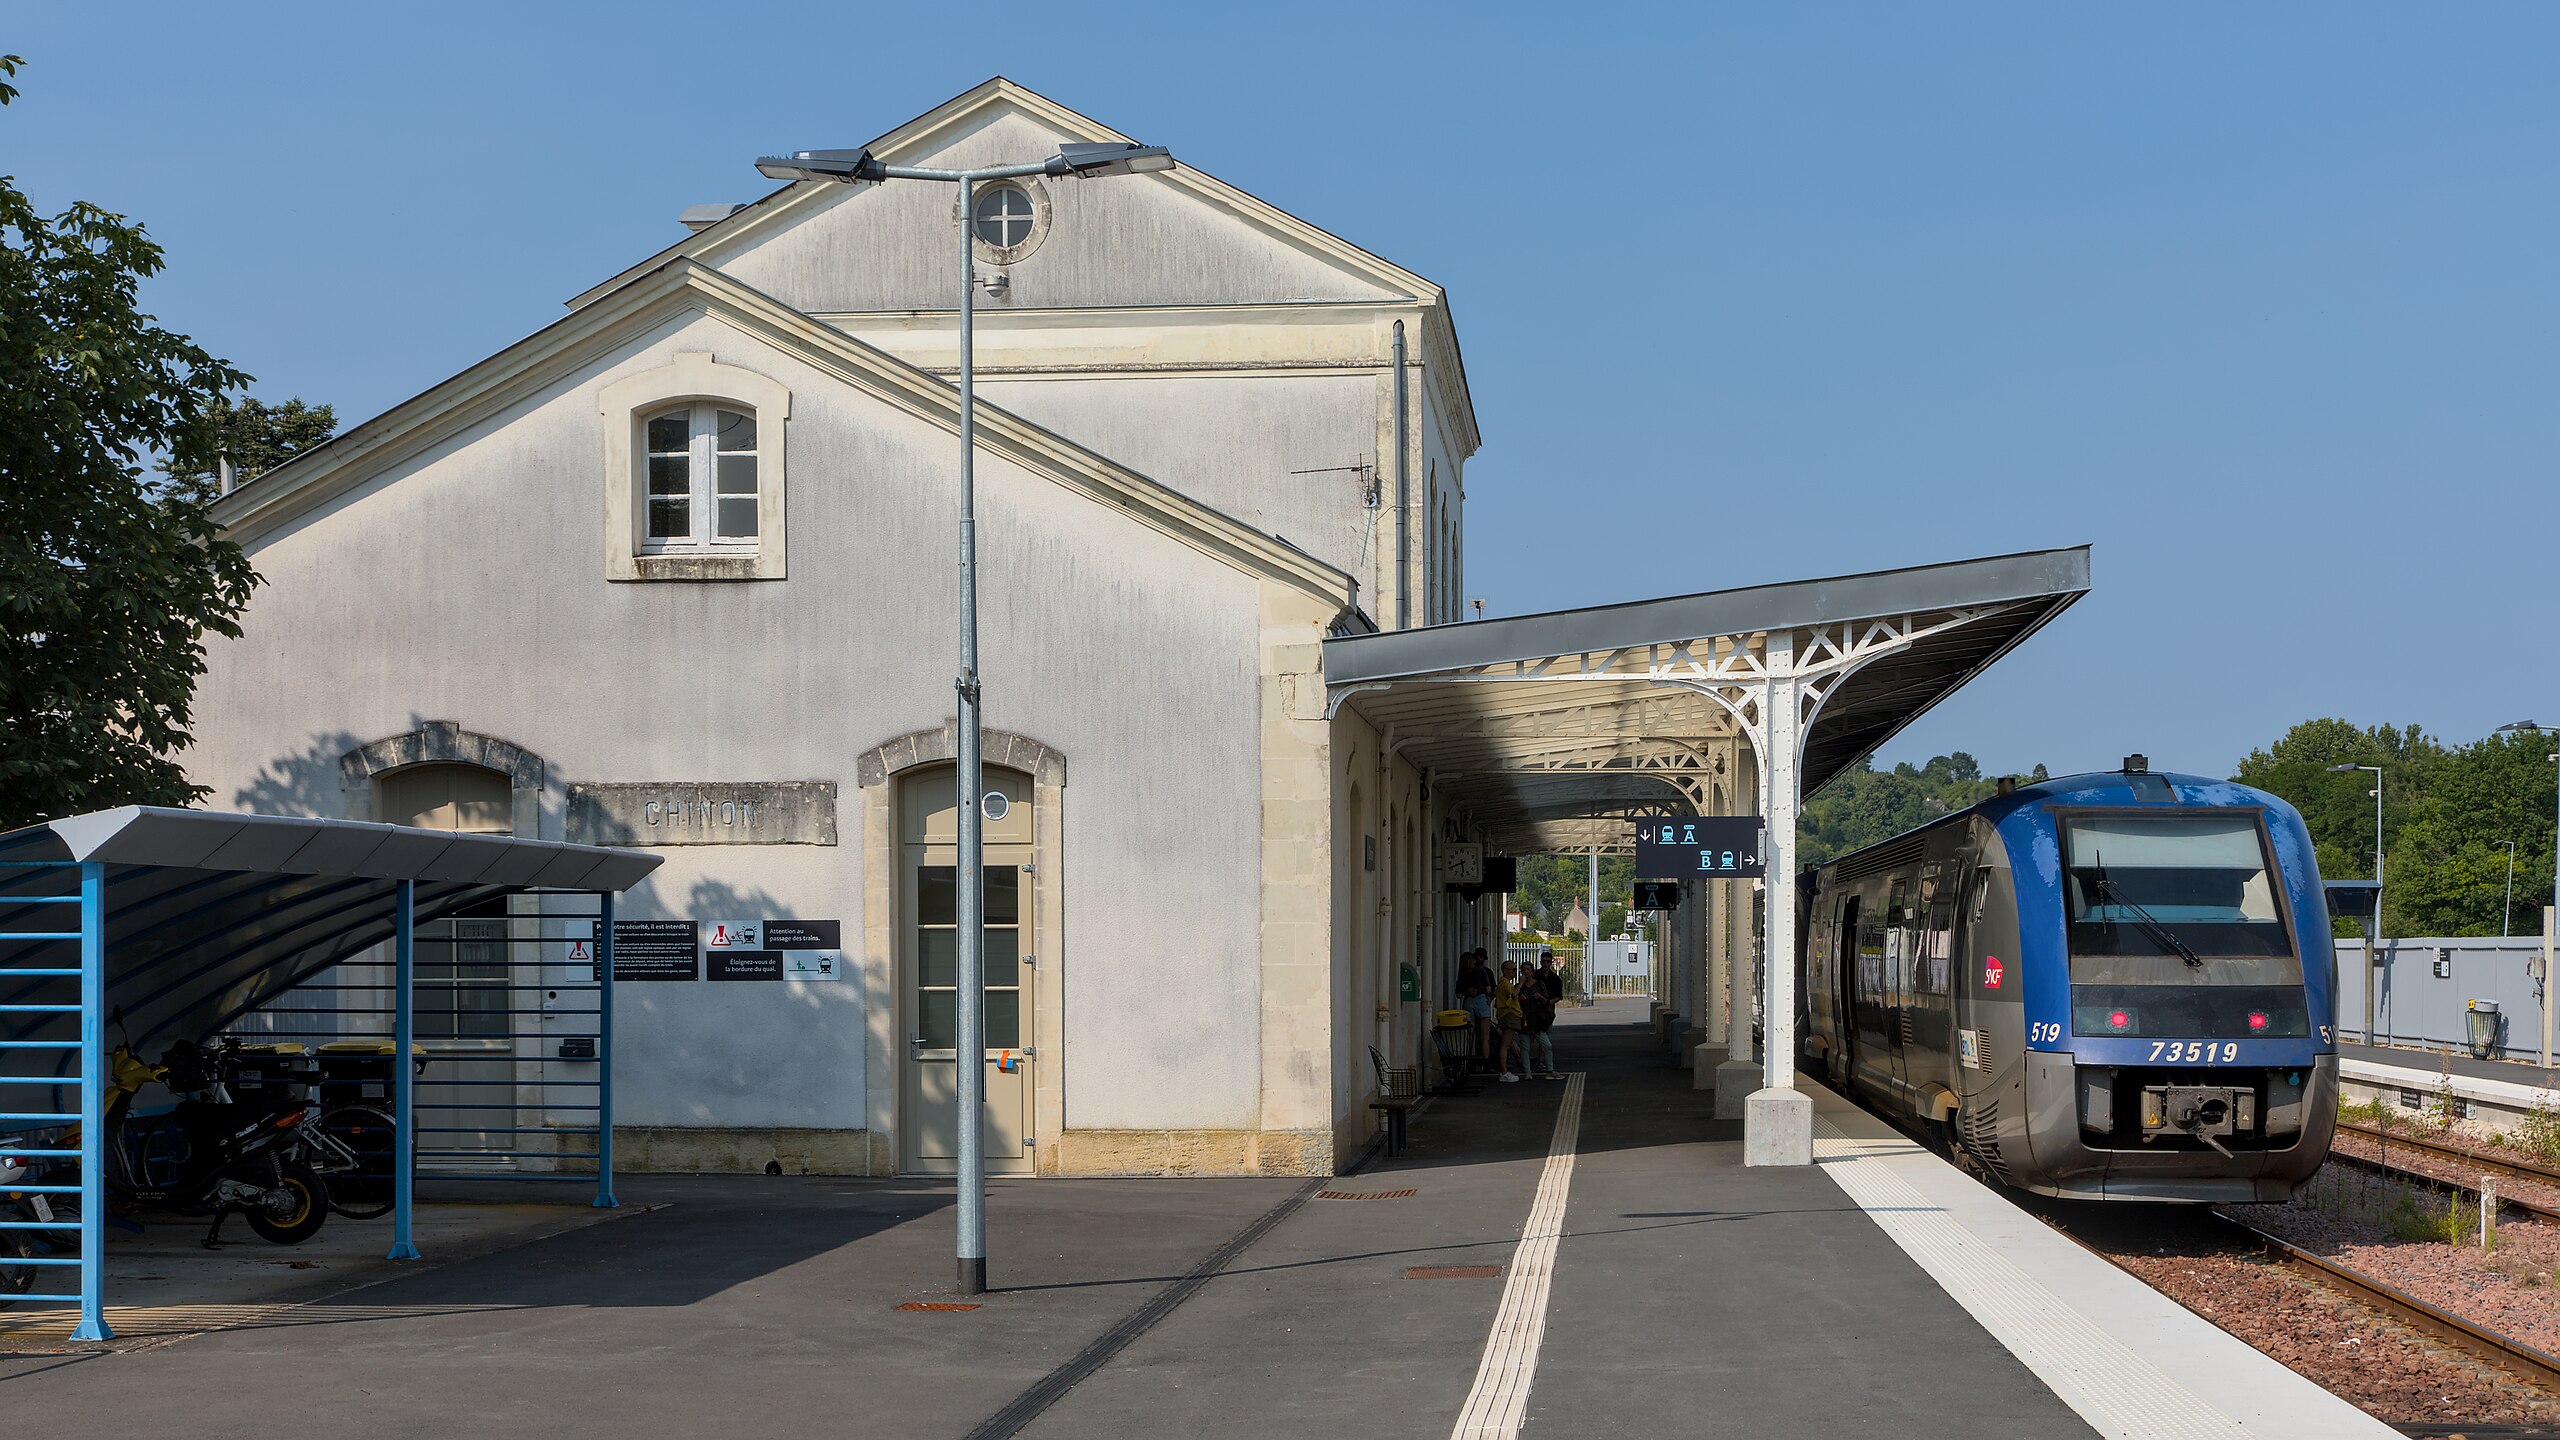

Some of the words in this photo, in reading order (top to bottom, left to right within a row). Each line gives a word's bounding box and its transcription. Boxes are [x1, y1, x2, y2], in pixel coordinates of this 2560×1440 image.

[645, 800, 757, 828] CHINON
[1684, 830, 1695, 842] A
[1701, 855, 1711, 868] B
[1645, 891, 1659, 906] A
[730, 958, 768, 966] Éloignez-vous
[1984, 968, 2003, 985] SNCF
[2031, 1022, 2061, 1043] 519
[2148, 1041, 2238, 1063] 73519
